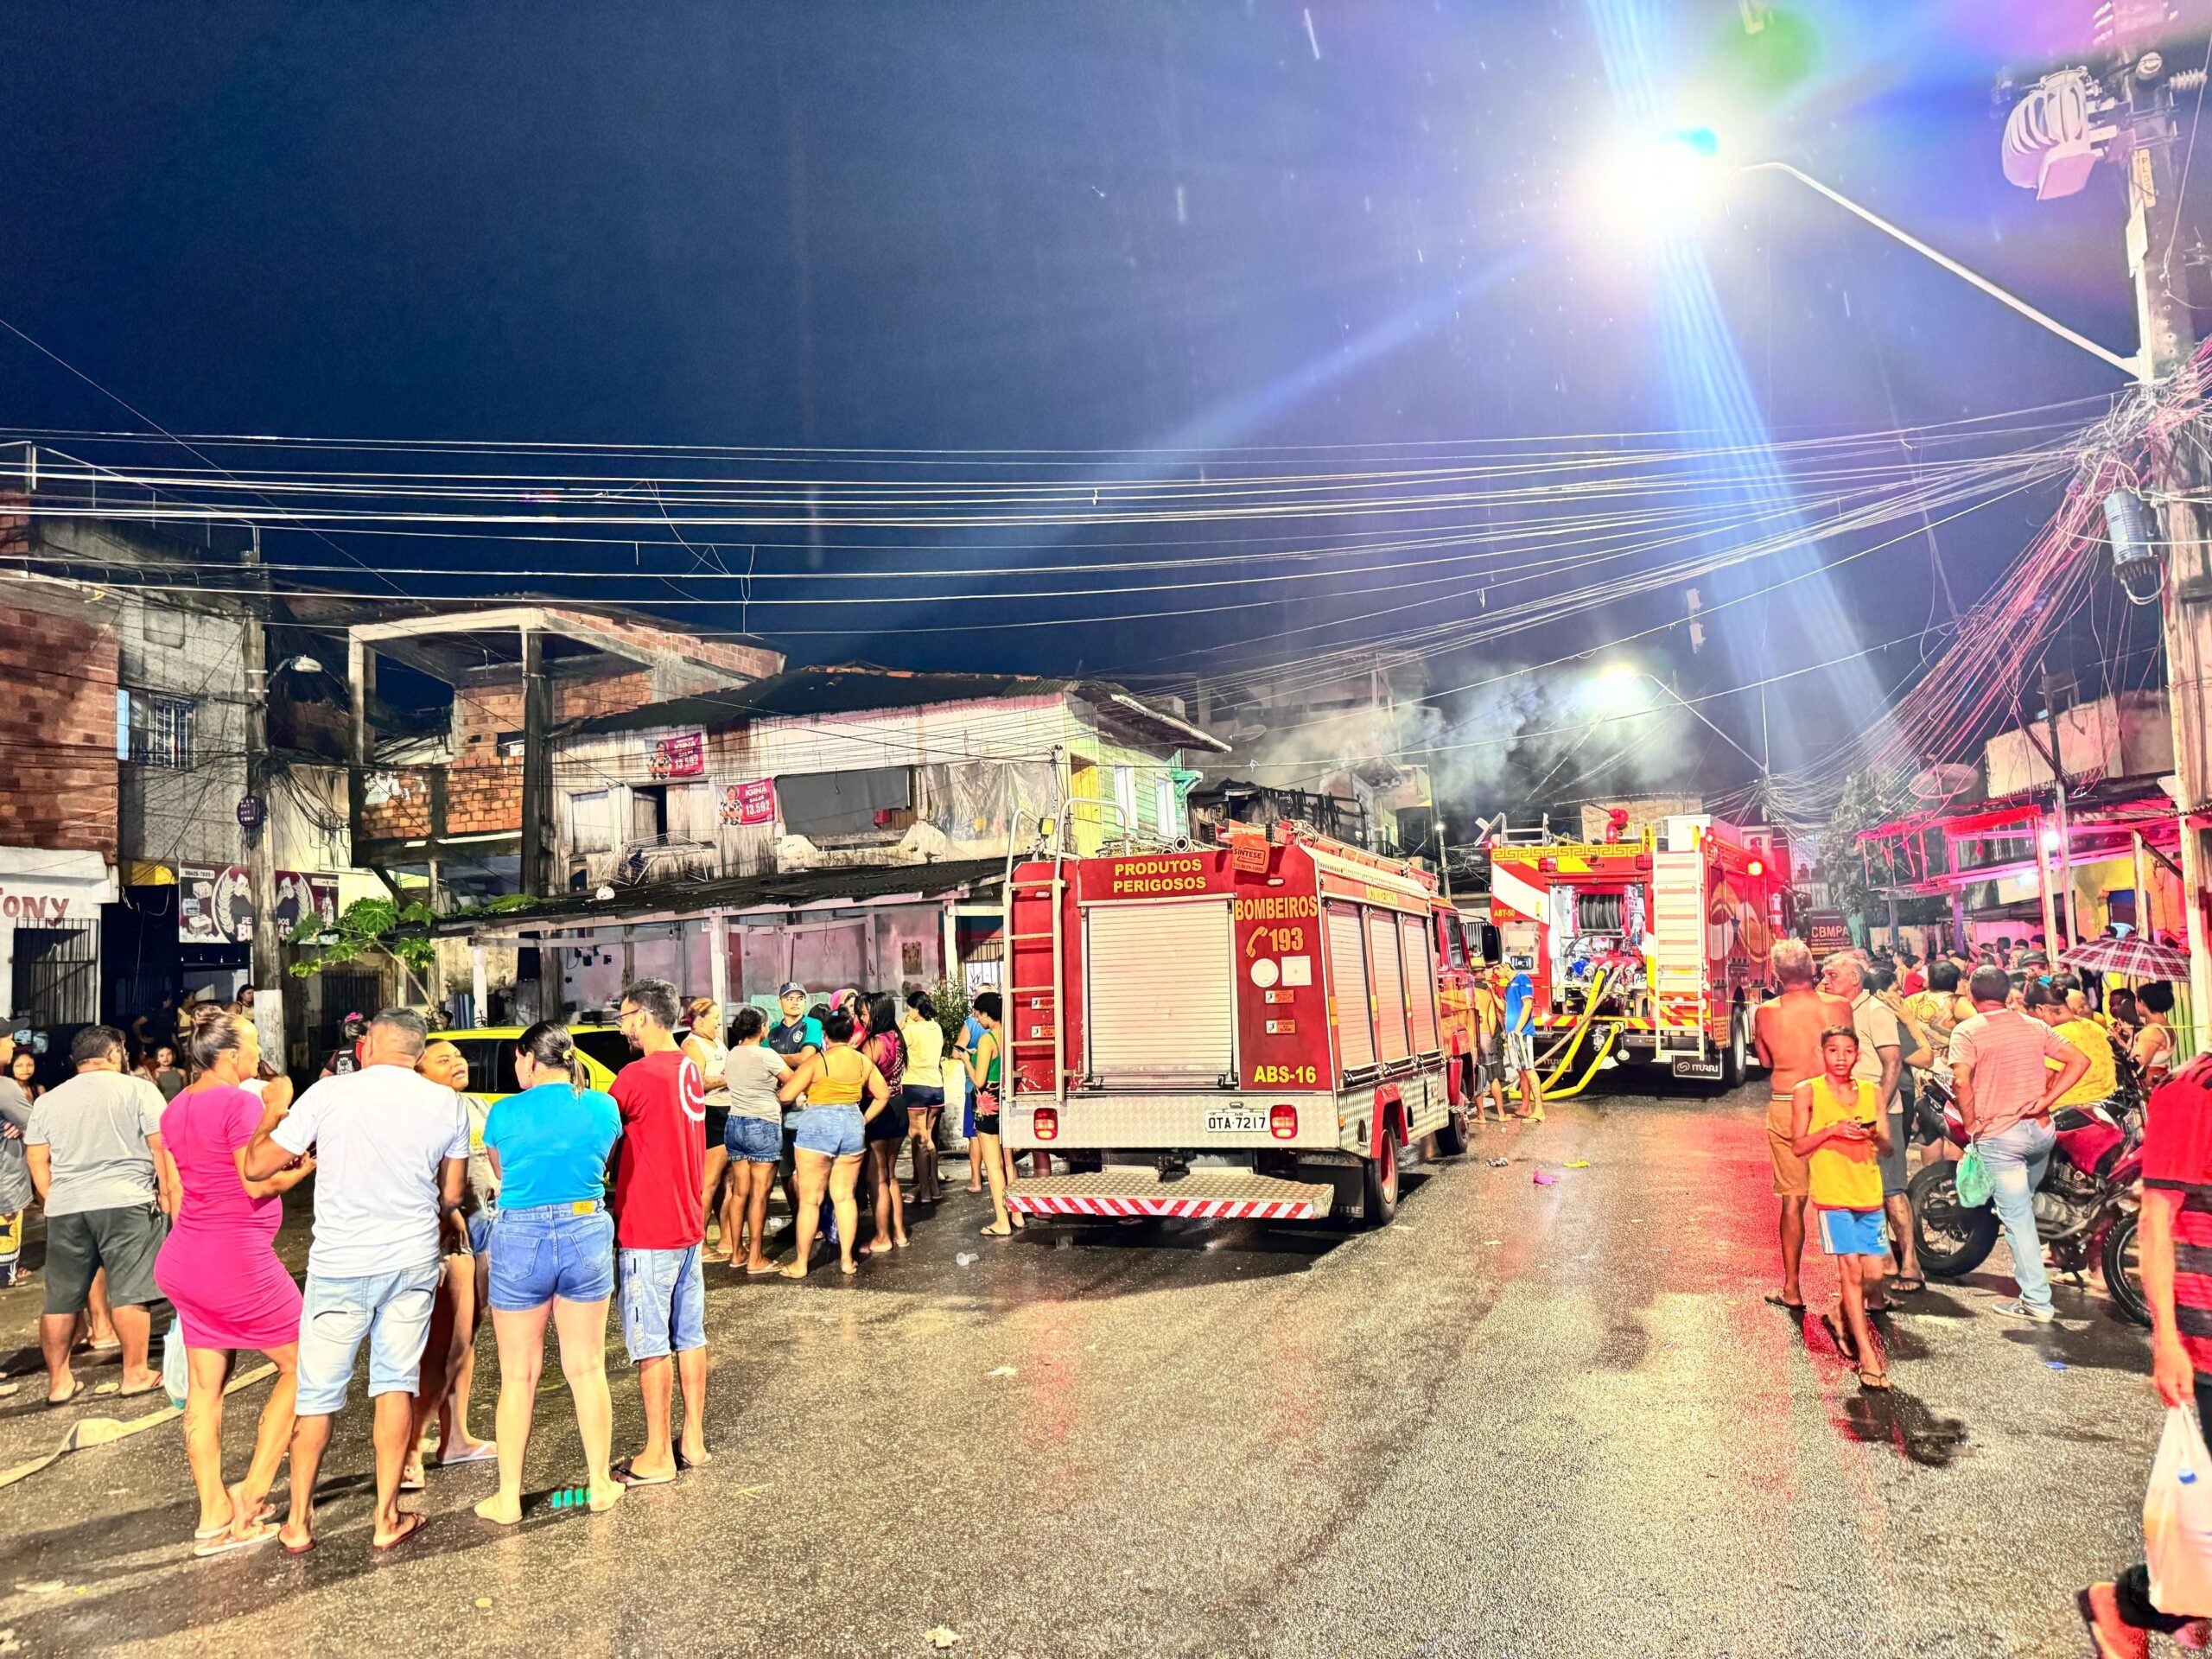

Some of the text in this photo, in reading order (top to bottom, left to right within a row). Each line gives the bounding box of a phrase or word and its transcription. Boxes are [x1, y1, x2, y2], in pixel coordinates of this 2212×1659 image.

[675, 754, 699, 770] 13.592
[745, 800, 771, 816] 13.592
[1115, 858, 1203, 876] PRODUTOS
[1113, 876, 1207, 893] PERIGOSOS
[0, 887, 69, 926] ONY
[1234, 895, 1318, 921] BOMBEIROS
[1494, 908, 1516, 918] ABT-50
[1268, 926, 1304, 952] 193
[1811, 925, 1850, 938] CBMPA
[1254, 1065, 1317, 1084] ABS-16
